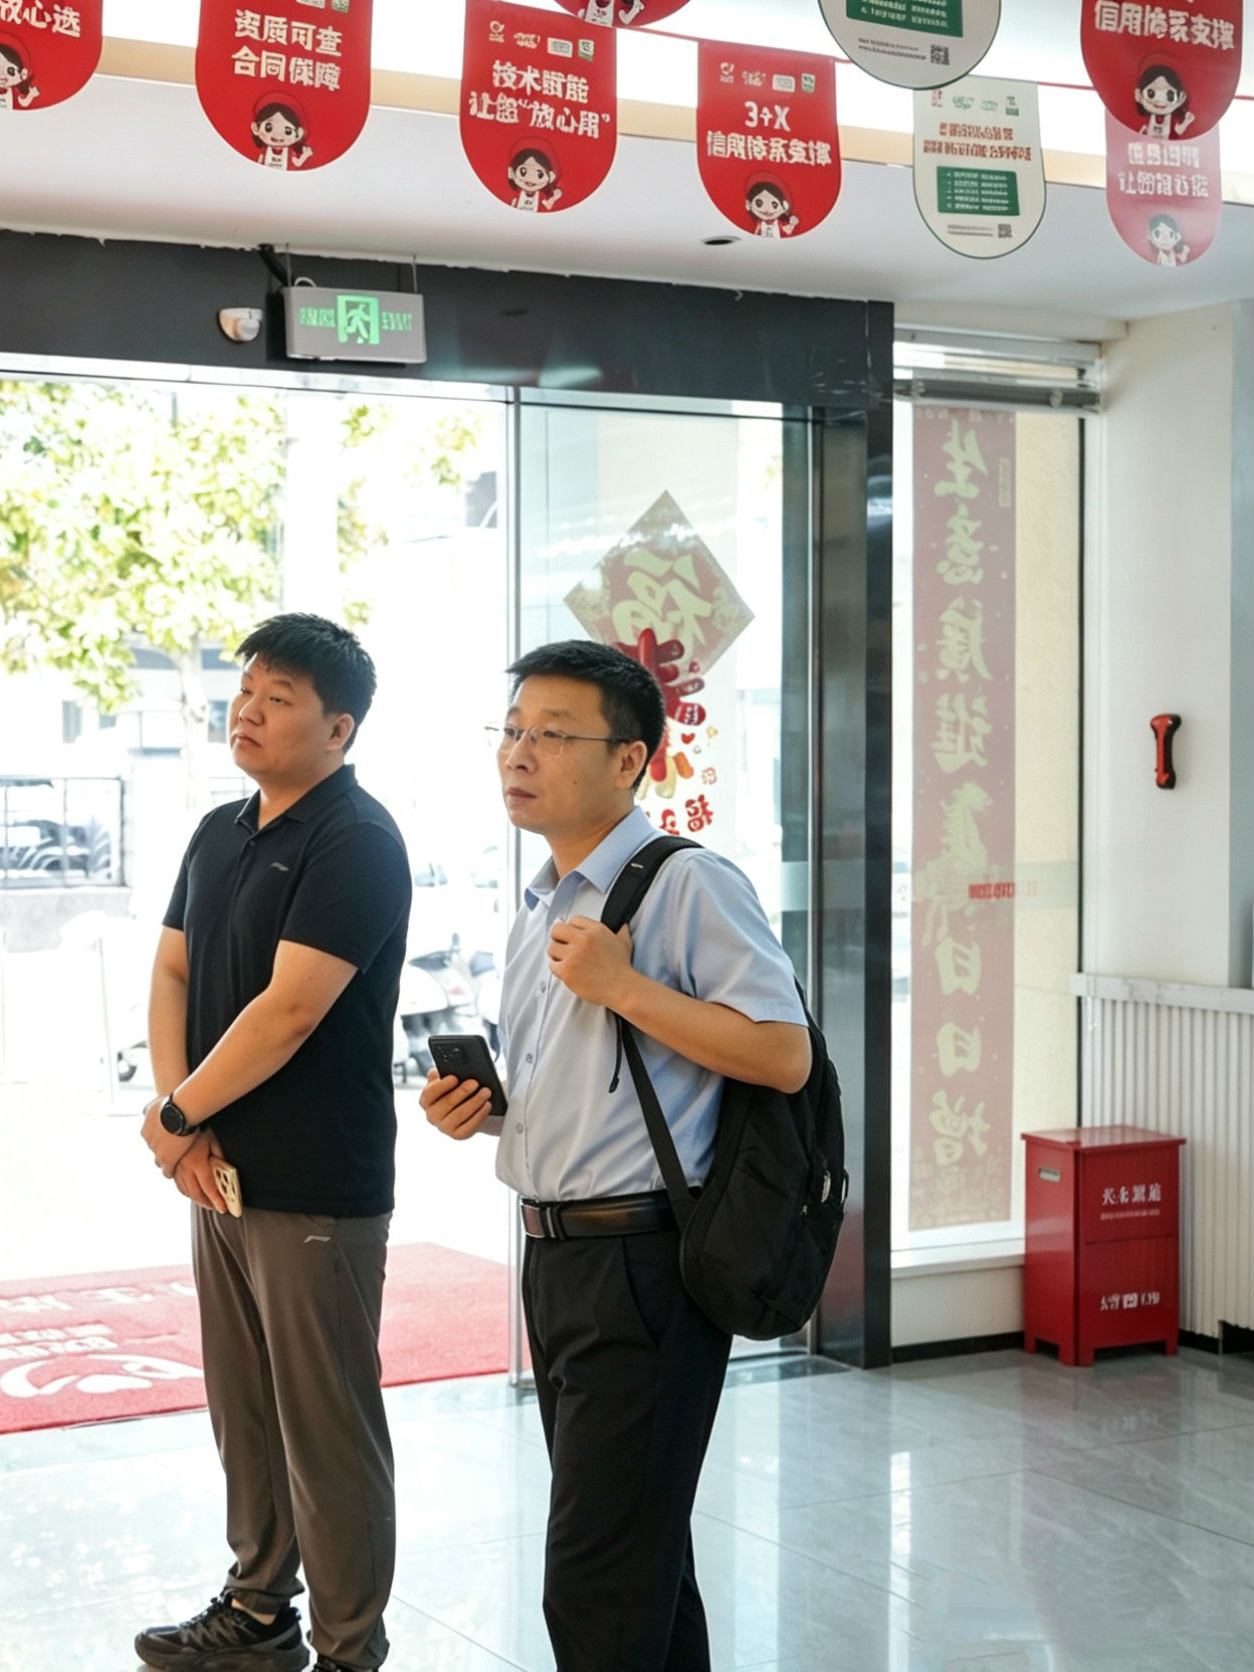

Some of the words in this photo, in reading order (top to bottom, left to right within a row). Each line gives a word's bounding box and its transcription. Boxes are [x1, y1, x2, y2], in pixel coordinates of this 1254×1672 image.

[234, 9, 343, 57] 资质可查
[231, 45, 341, 91] 合同保障
[492, 60, 589, 103] 技术赋能
